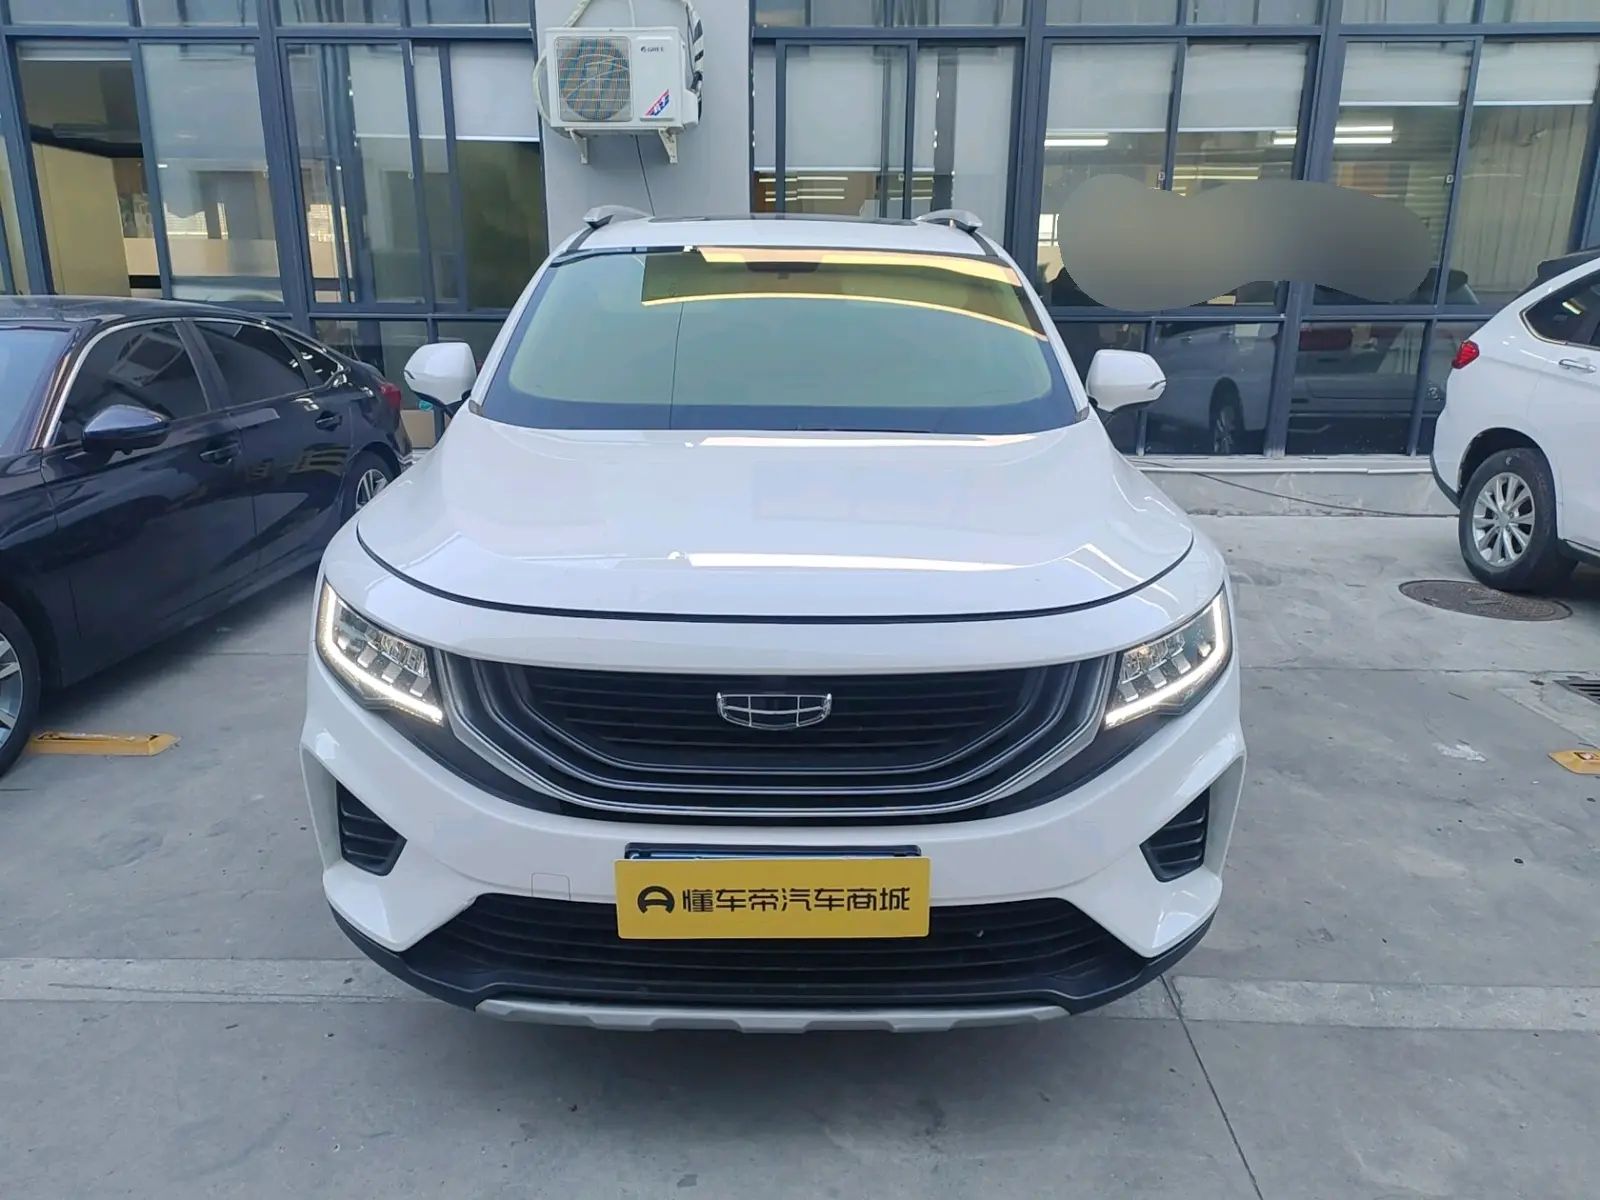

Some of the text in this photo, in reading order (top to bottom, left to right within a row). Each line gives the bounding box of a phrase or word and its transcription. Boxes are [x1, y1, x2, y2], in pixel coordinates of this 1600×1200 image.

[682, 886, 910, 913] 懂车帝汽车商城
